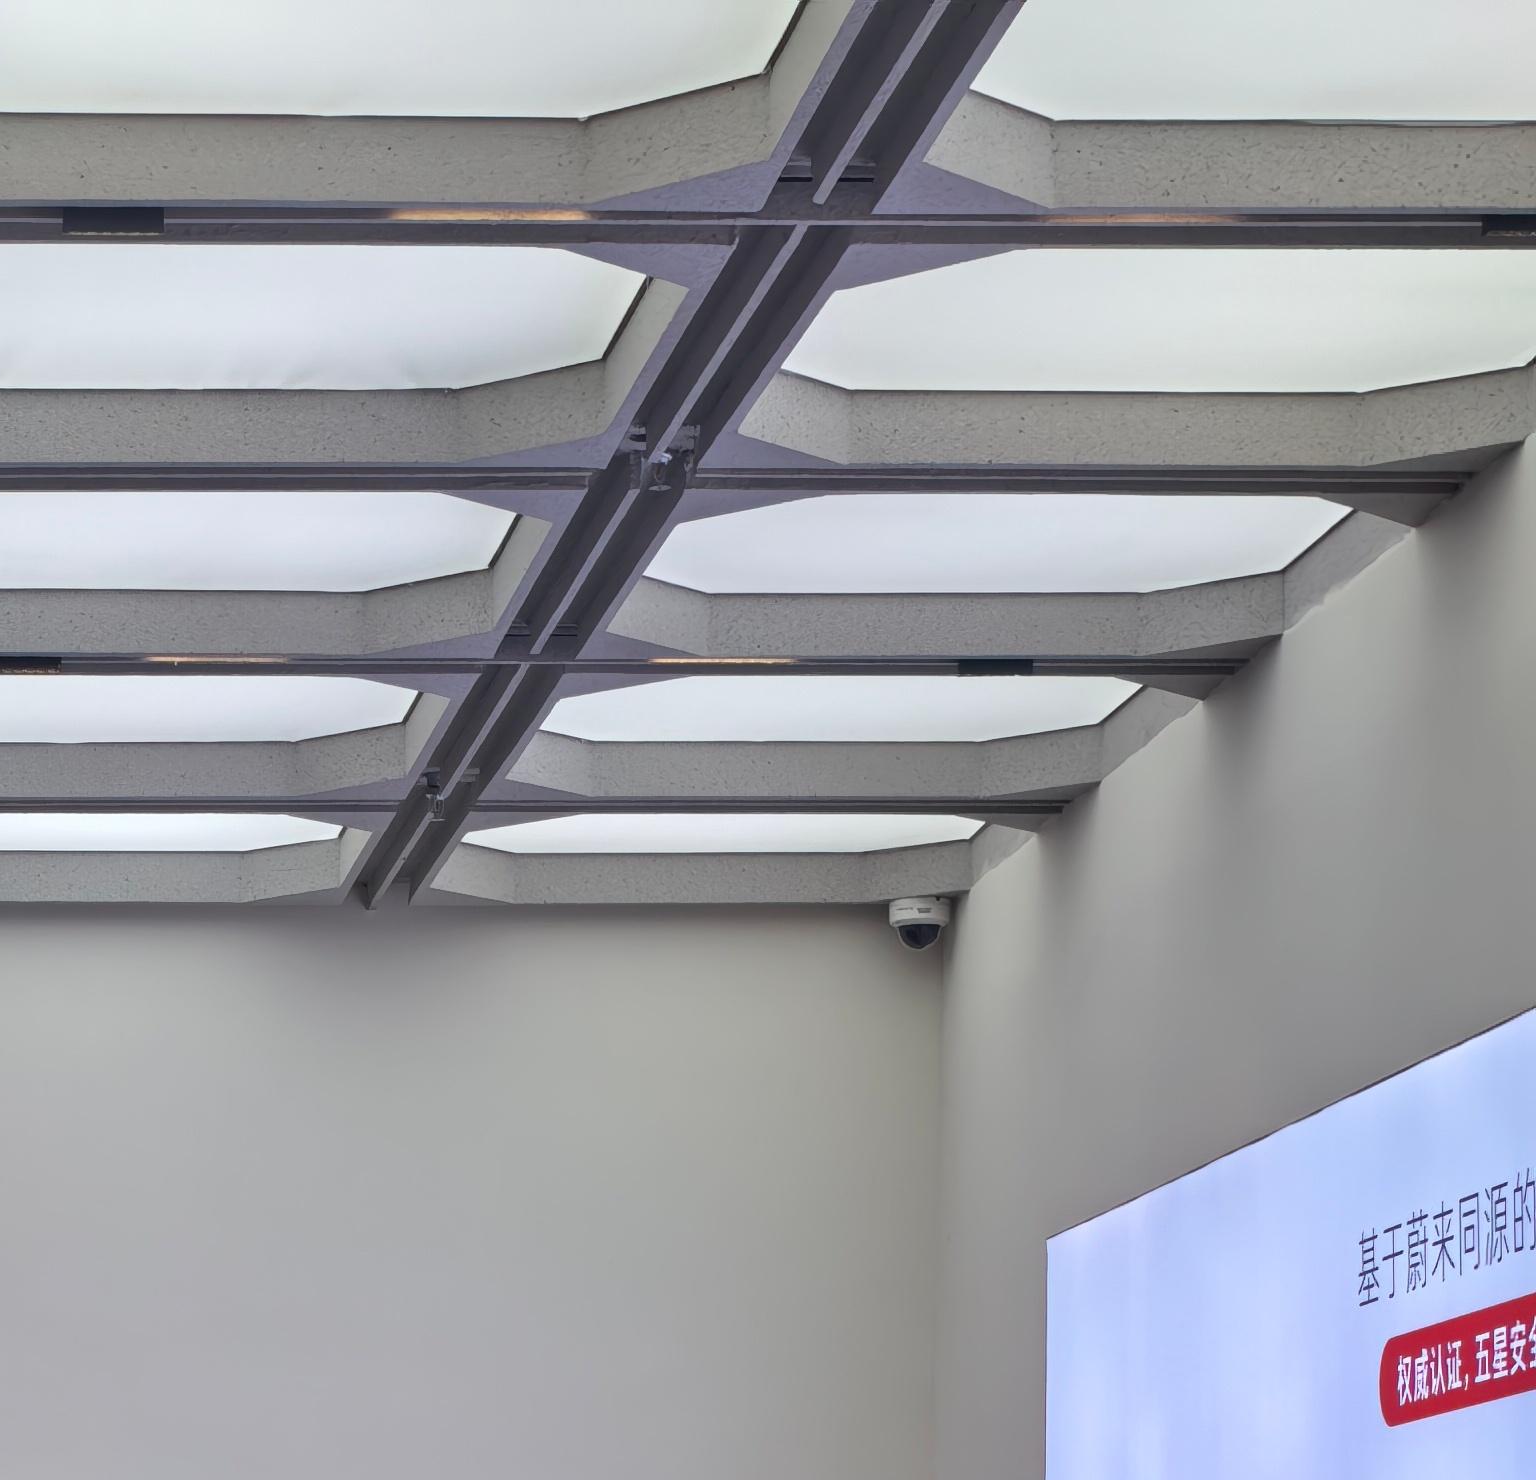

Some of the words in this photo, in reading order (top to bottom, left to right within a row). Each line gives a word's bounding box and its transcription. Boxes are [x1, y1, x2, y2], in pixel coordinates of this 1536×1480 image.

[1357, 1167, 1536, 1307] 基于蔚来同源的
